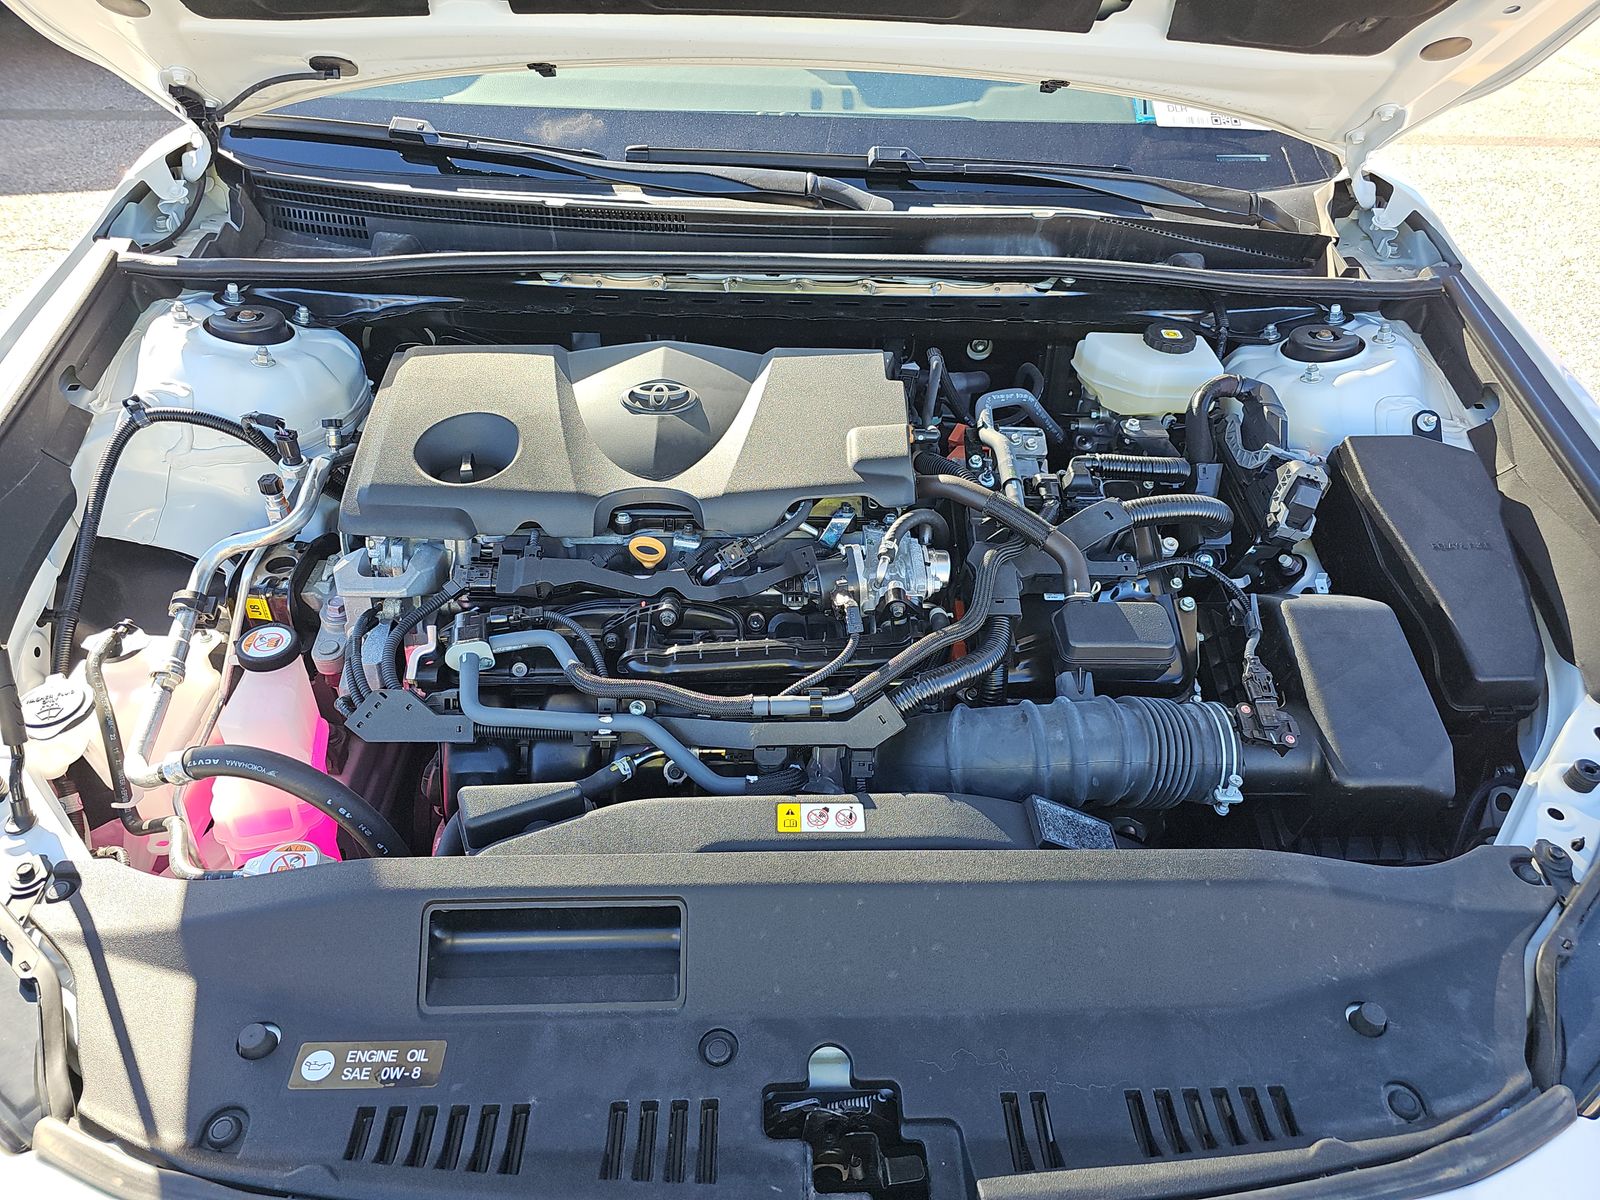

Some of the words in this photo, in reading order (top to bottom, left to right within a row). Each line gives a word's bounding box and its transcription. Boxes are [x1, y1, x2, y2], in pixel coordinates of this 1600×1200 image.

[225, 759, 267, 774] YOKOHAMA
[346, 1050, 399, 1063] ENGINE
[406, 1049, 429, 1062] OIL
[341, 1067, 372, 1081] SAE
[380, 1066, 422, 1081] 0W-8
